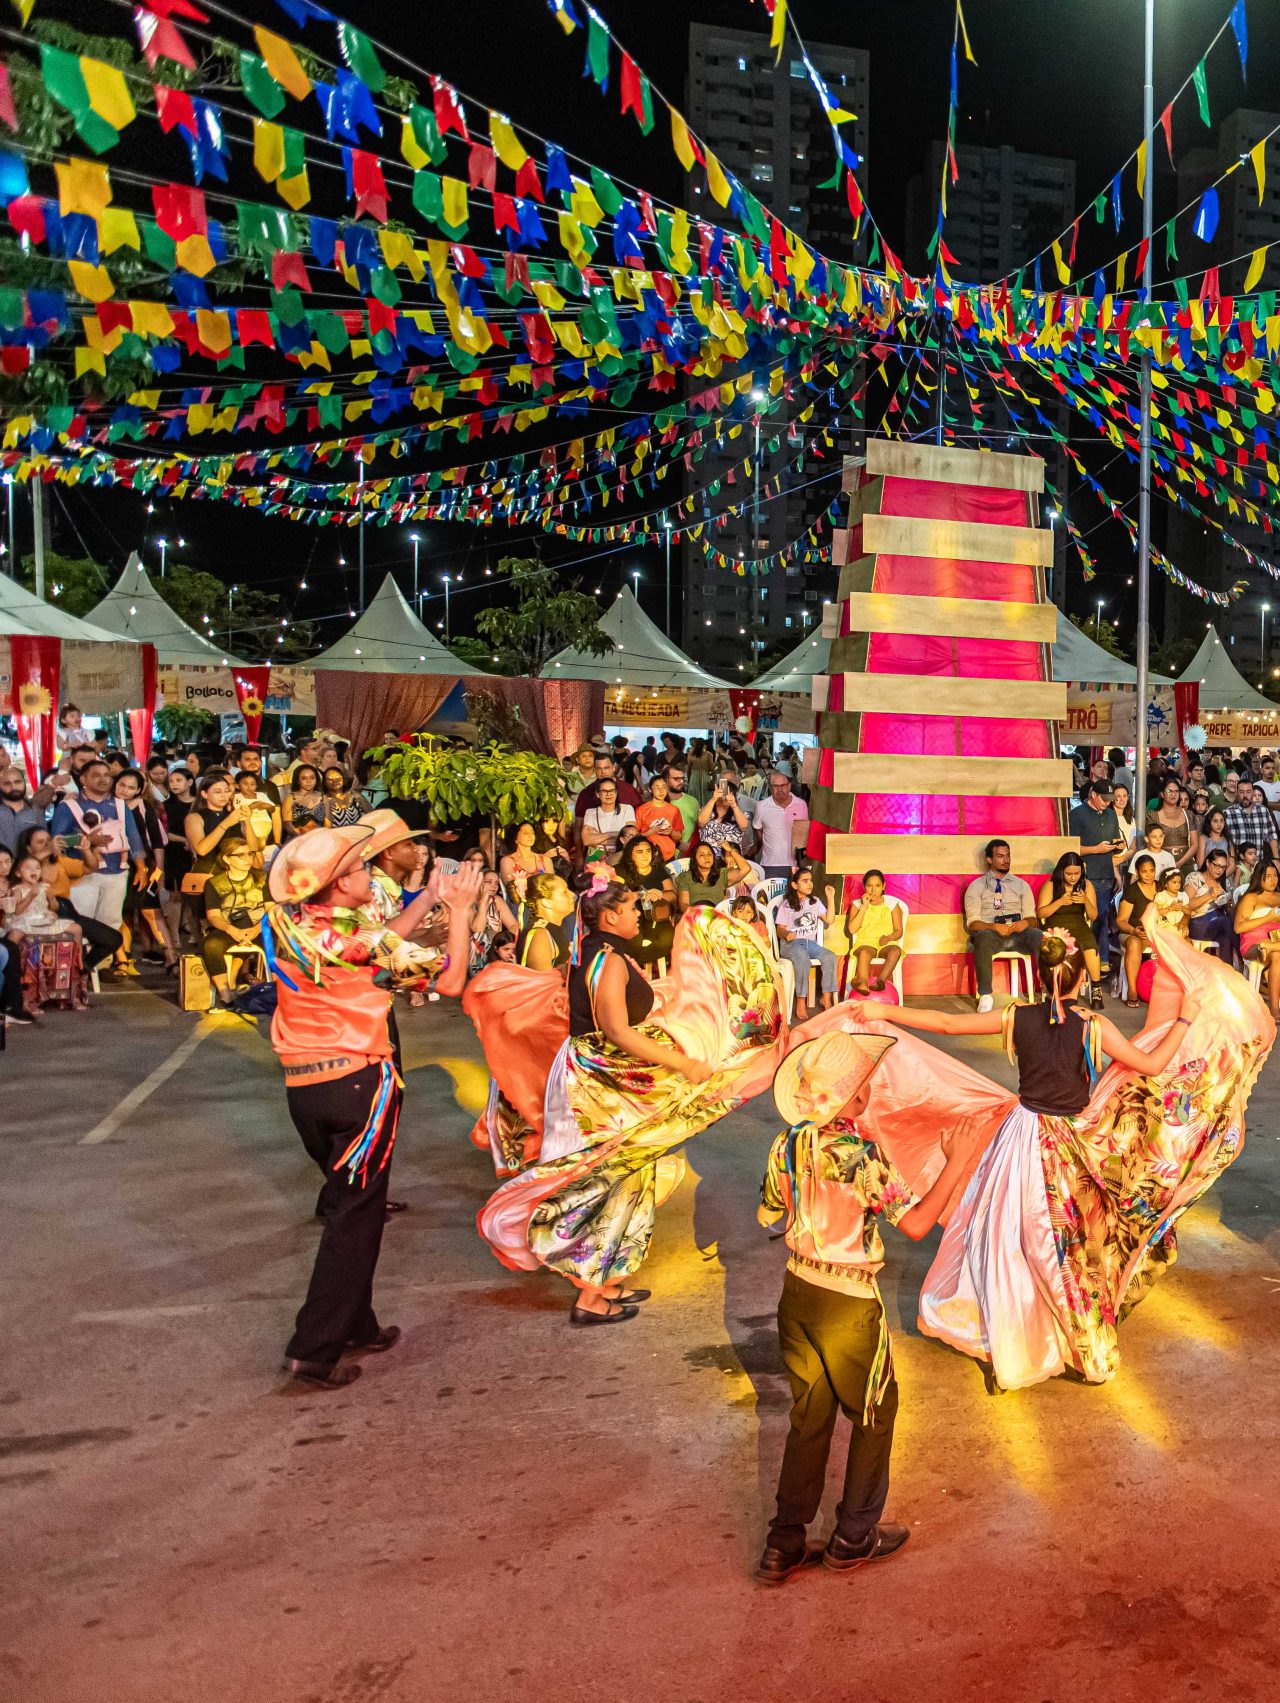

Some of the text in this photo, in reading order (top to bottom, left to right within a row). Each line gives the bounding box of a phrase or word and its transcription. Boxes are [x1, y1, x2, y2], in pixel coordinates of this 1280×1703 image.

[185, 685, 234, 700] Bollato
[621, 702, 680, 717] RECHEADA
[1203, 723, 1232, 736] CREPE
[1242, 724, 1279, 737] TAPIOCA
